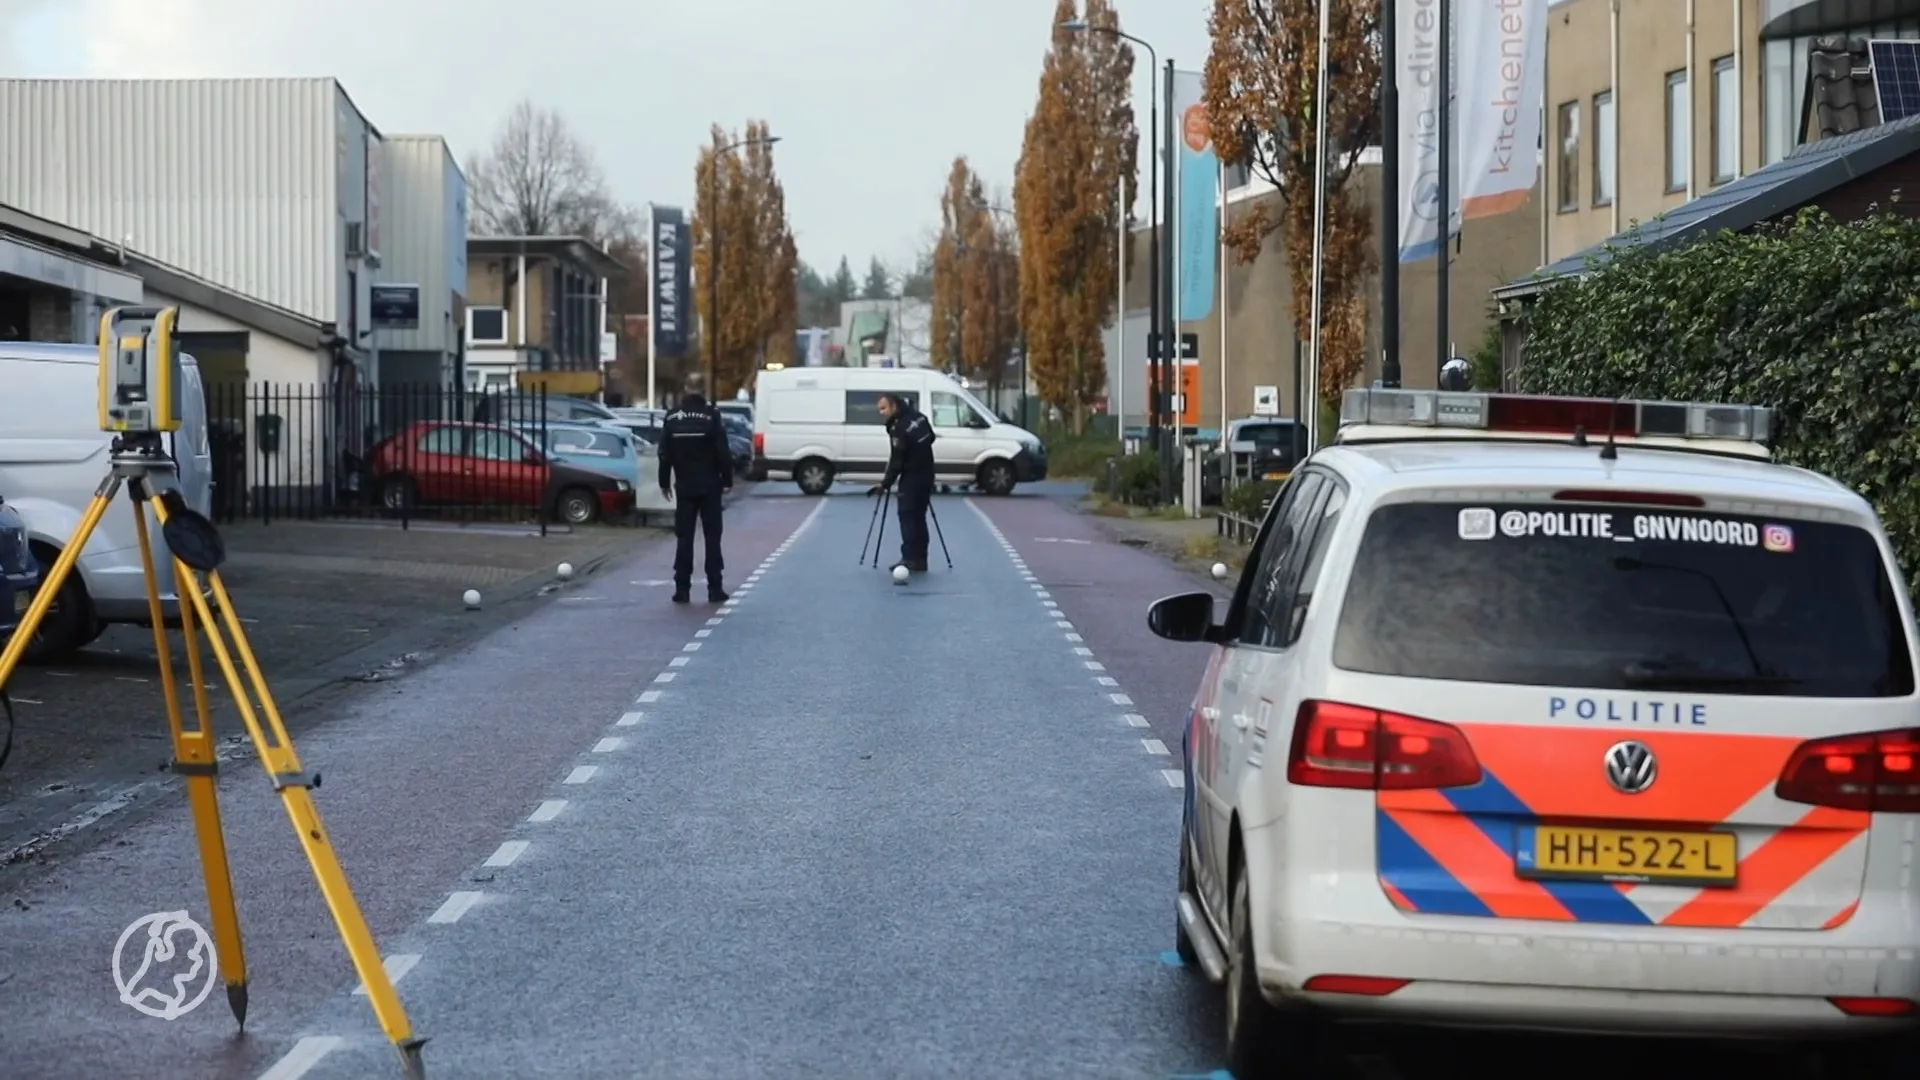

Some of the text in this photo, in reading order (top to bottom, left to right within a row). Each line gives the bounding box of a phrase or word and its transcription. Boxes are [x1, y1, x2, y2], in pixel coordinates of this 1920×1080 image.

[659, 223, 676, 331] KARWEI
[1500, 510, 1759, 547] @POLITIE_GNVNOORD
[1549, 697, 1707, 725] POLITIE
[1549, 833, 1722, 871] HH-522-L
